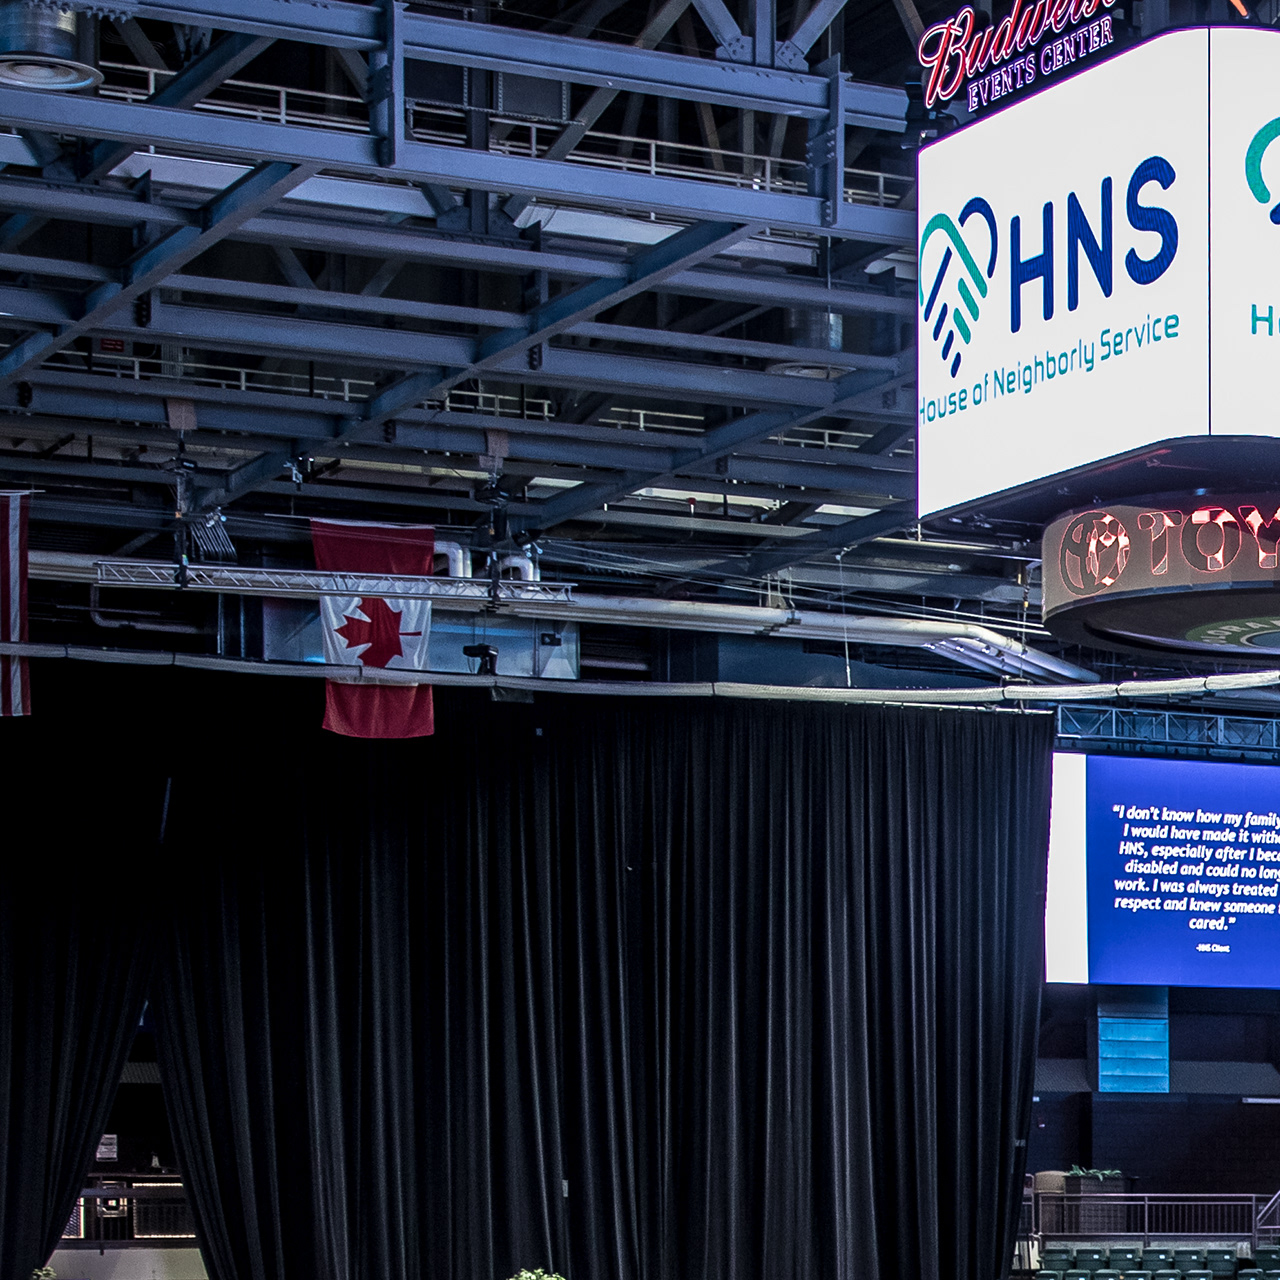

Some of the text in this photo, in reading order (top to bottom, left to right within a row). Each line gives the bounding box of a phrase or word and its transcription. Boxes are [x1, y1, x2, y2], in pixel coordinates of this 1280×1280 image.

[968, 53, 1035, 113] EVENTS
[1041, 16, 1113, 75] CENTER
[1010, 156, 1178, 333] HNS
[973, 373, 988, 405] of
[994, 339, 1095, 399] Neighborly
[1100, 314, 1179, 360] Service
[1162, 807, 1194, 822] know
[1196, 809, 1222, 823] how
[1223, 813, 1243, 827] my
[1123, 824, 1129, 836] I
[1131, 825, 1168, 839] would
[1170, 827, 1200, 841] have
[1202, 829, 1237, 842] made
[1238, 829, 1249, 843] it
[1119, 842, 1148, 858] HNS,
[1151, 844, 1213, 861] especially
[1215, 848, 1247, 862] after
[1250, 848, 1254, 860] I
[1125, 860, 1178, 875] disabled
[1180, 863, 1204, 876] and
[1206, 864, 1239, 877] could
[1241, 867, 1257, 878] no
[1114, 878, 1150, 892] work.
[1152, 879, 1158, 892] I
[1160, 882, 1185, 893] was
[1187, 880, 1230, 897] always
[1232, 883, 1278, 897] treated
[1114, 897, 1161, 912] respect
[1163, 897, 1187, 911] and
[1189, 898, 1222, 912] knew
[1223, 902, 1275, 914] someone
